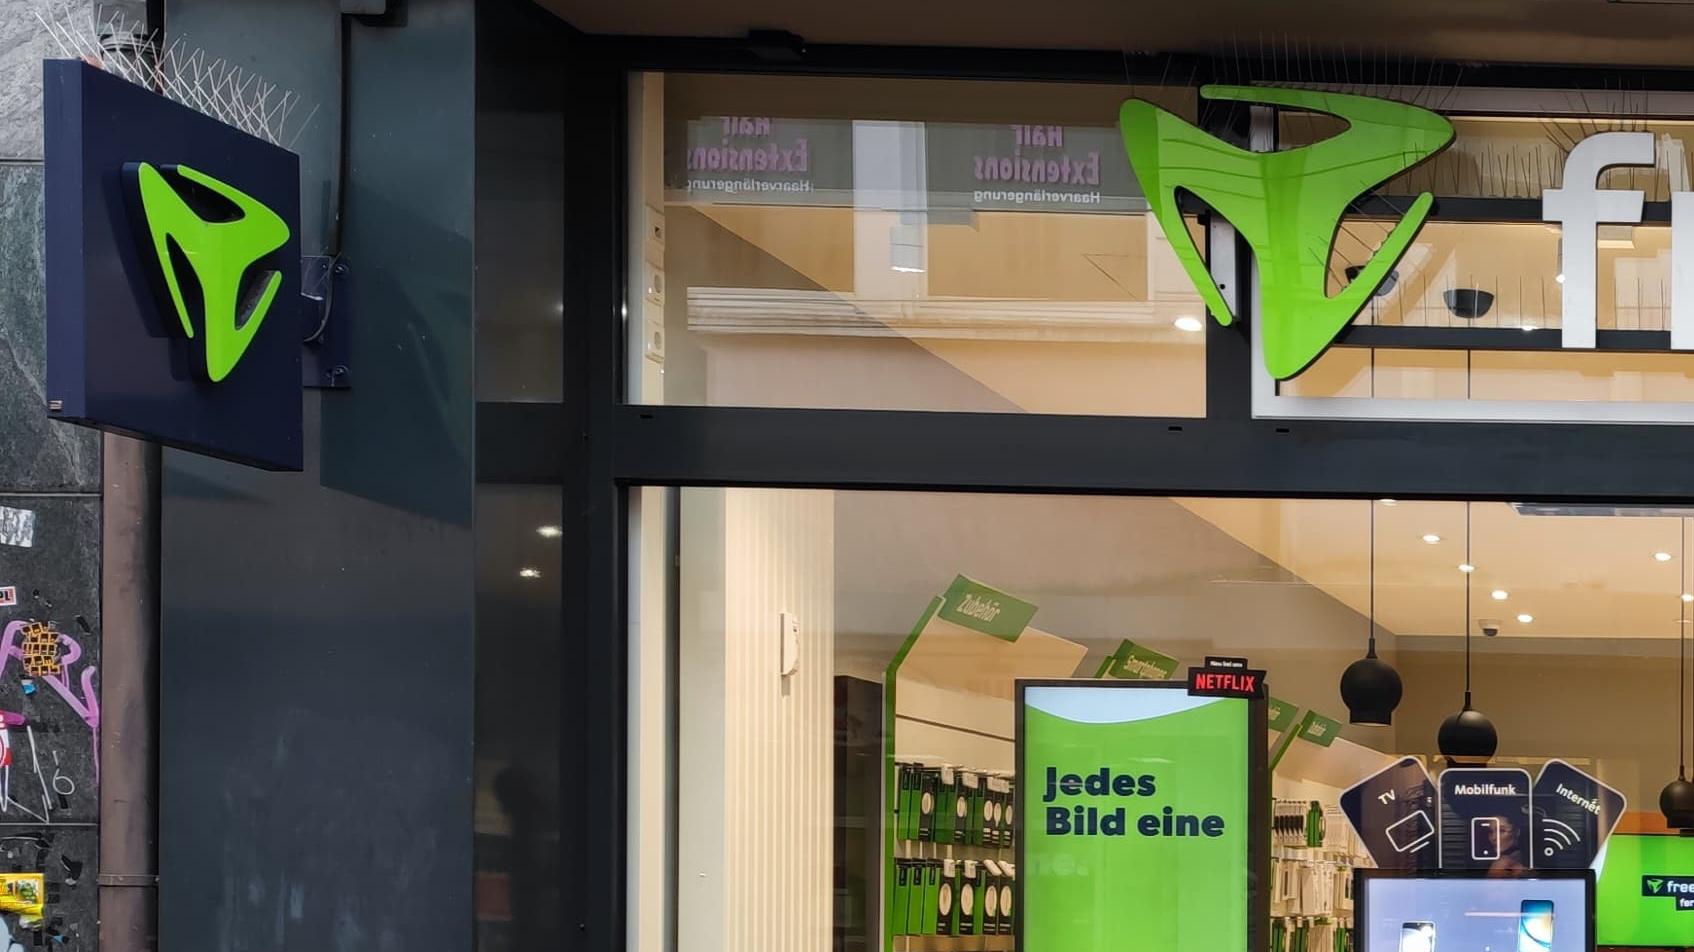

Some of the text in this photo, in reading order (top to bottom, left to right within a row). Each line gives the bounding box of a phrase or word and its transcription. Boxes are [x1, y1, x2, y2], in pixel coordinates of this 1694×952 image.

[956, 594, 1001, 622] Zubehör
[1195, 673, 1256, 692] NETFLIX
[1043, 766, 1156, 802] Jedes
[1378, 789, 1396, 805] TV
[1454, 784, 1517, 796] Mobilfunk
[1555, 783, 1602, 816] Internet
[1046, 806, 1226, 837] Bild eine
